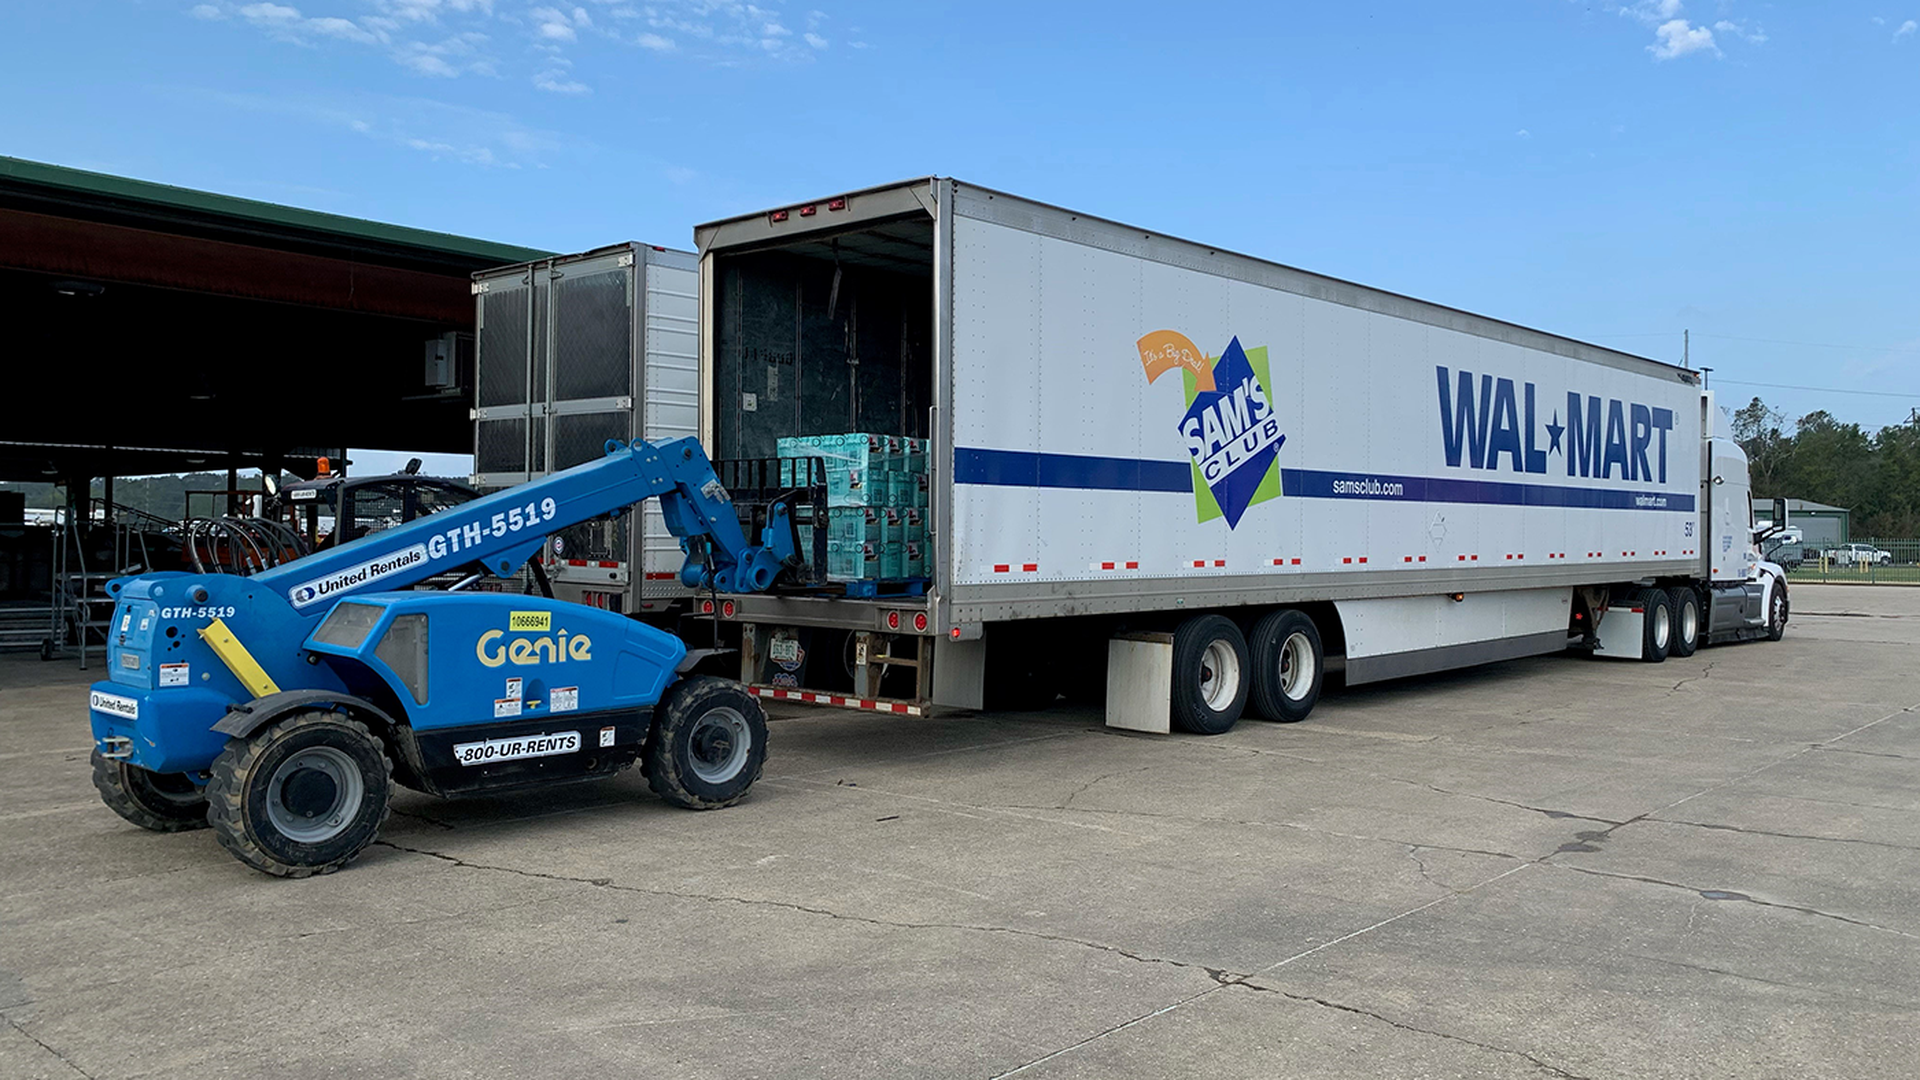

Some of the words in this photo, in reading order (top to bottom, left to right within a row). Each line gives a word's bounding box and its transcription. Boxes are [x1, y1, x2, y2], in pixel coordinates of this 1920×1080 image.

[1183, 376, 1270, 464] SAM'S
[1205, 419, 1278, 480] CLUB
[1333, 478, 1404, 495] samsclub.com
[1635, 494, 1667, 507] walmart.com
[428, 497, 556, 560] GTH-5519
[318, 569, 367, 596] United
[370, 550, 421, 577] Rentals
[161, 606, 235, 618] GTH-5519
[511, 615, 549, 627] 10666941
[476, 628, 592, 668] Genie
